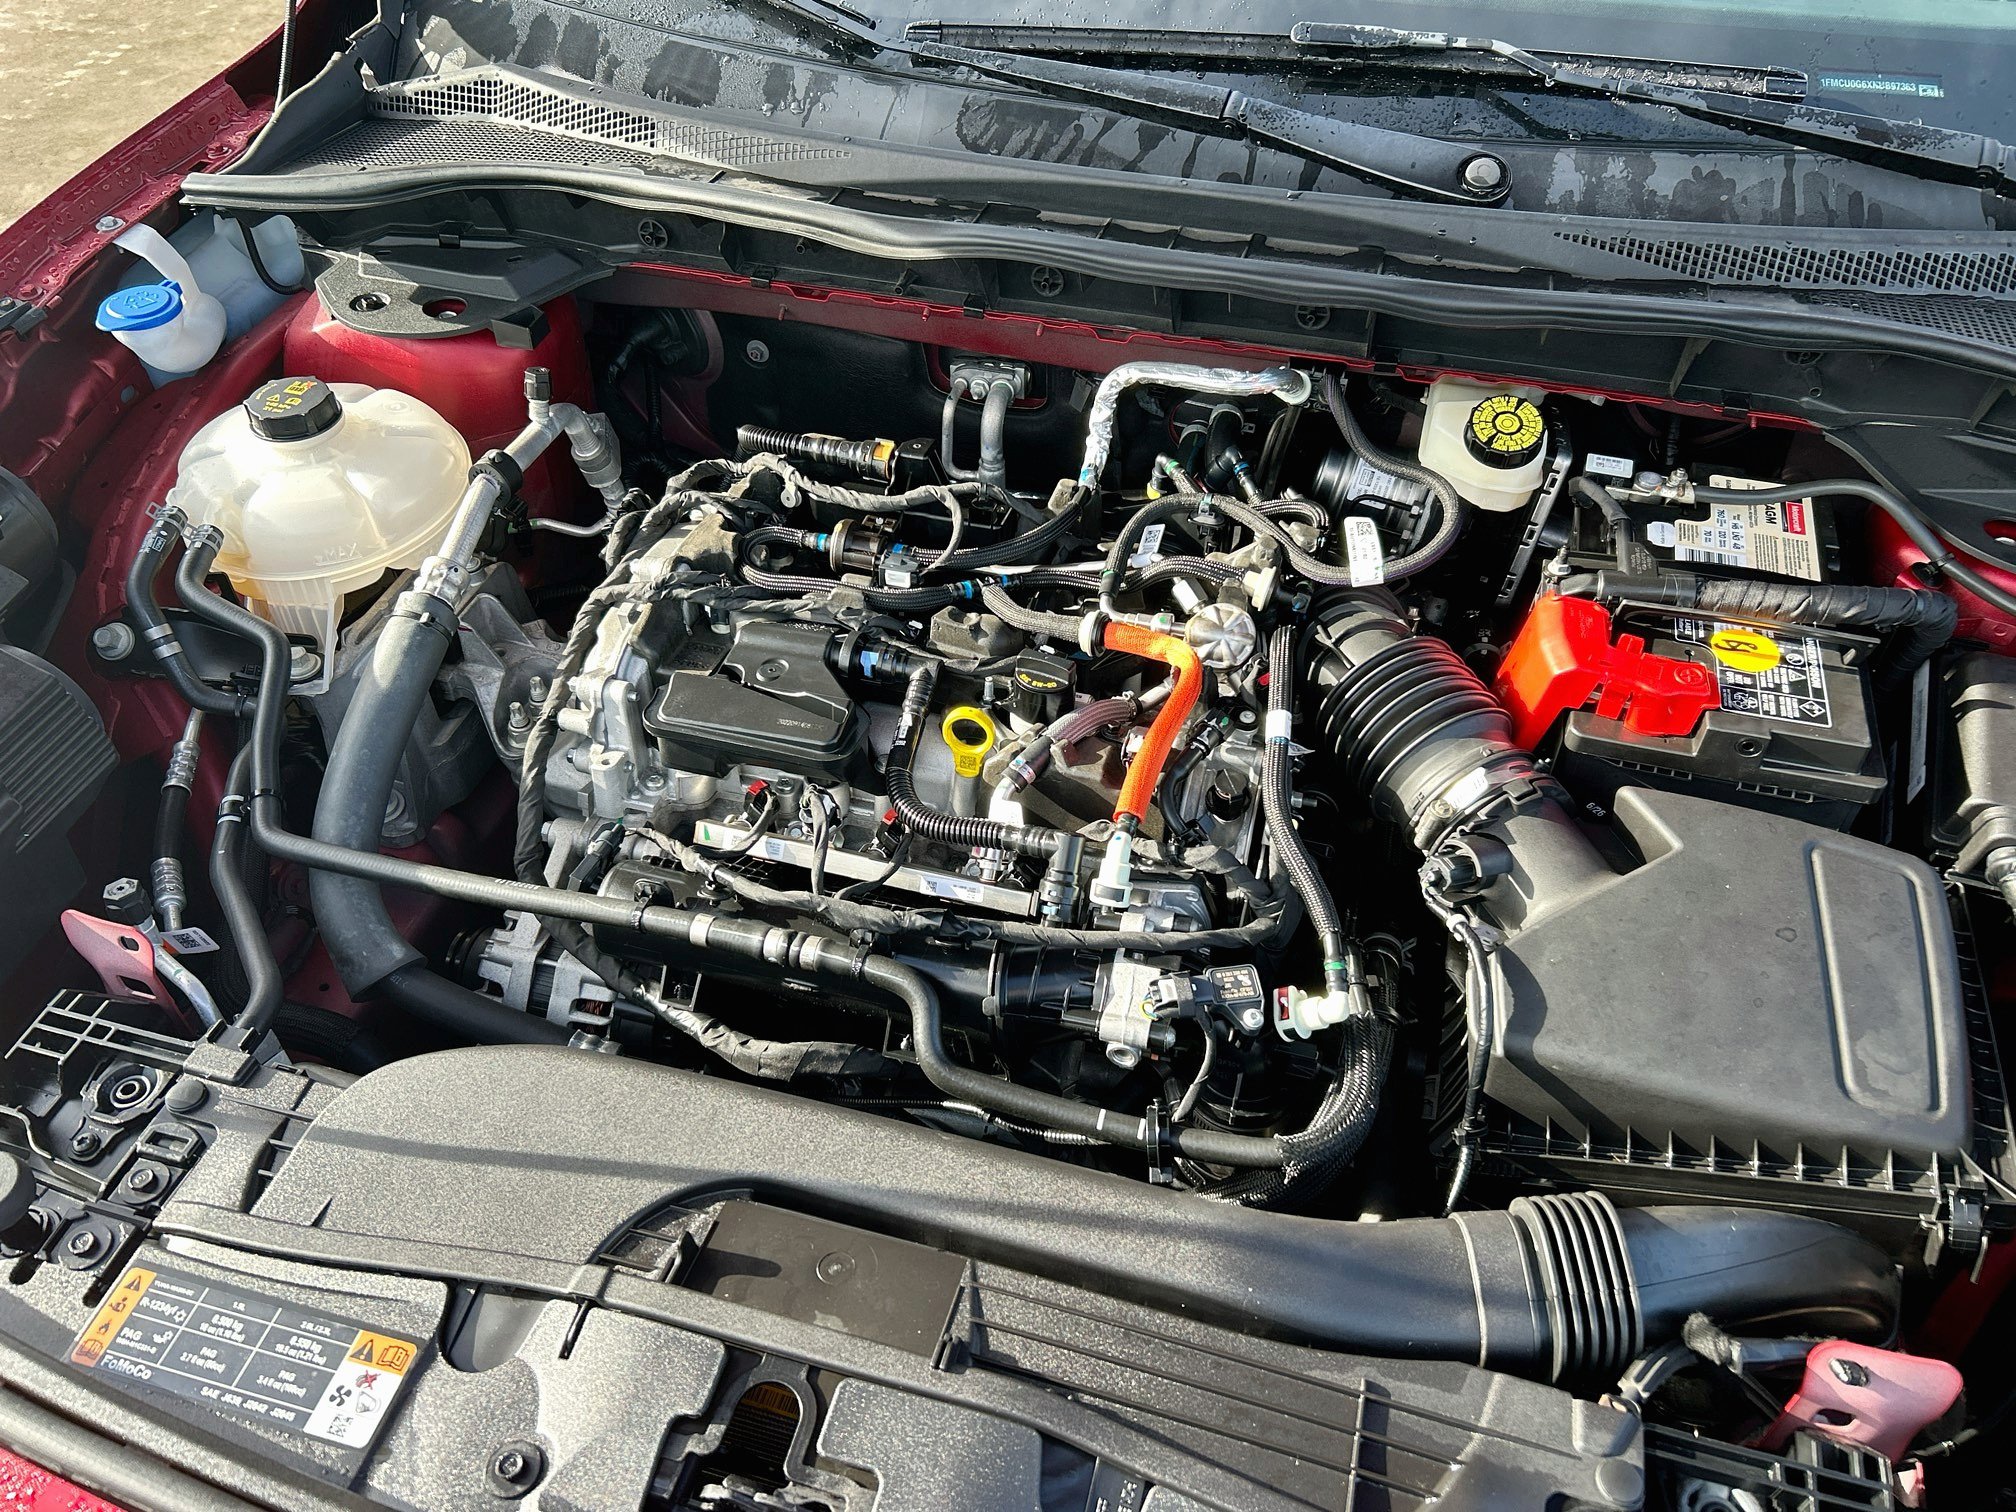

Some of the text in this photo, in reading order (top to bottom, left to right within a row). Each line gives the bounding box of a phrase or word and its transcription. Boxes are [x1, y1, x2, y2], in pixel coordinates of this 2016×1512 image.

[1791, 505, 1802, 532] Motorcraft
[121, 1327, 143, 1339] PAG
[101, 1355, 152, 1380] FoMoCo
